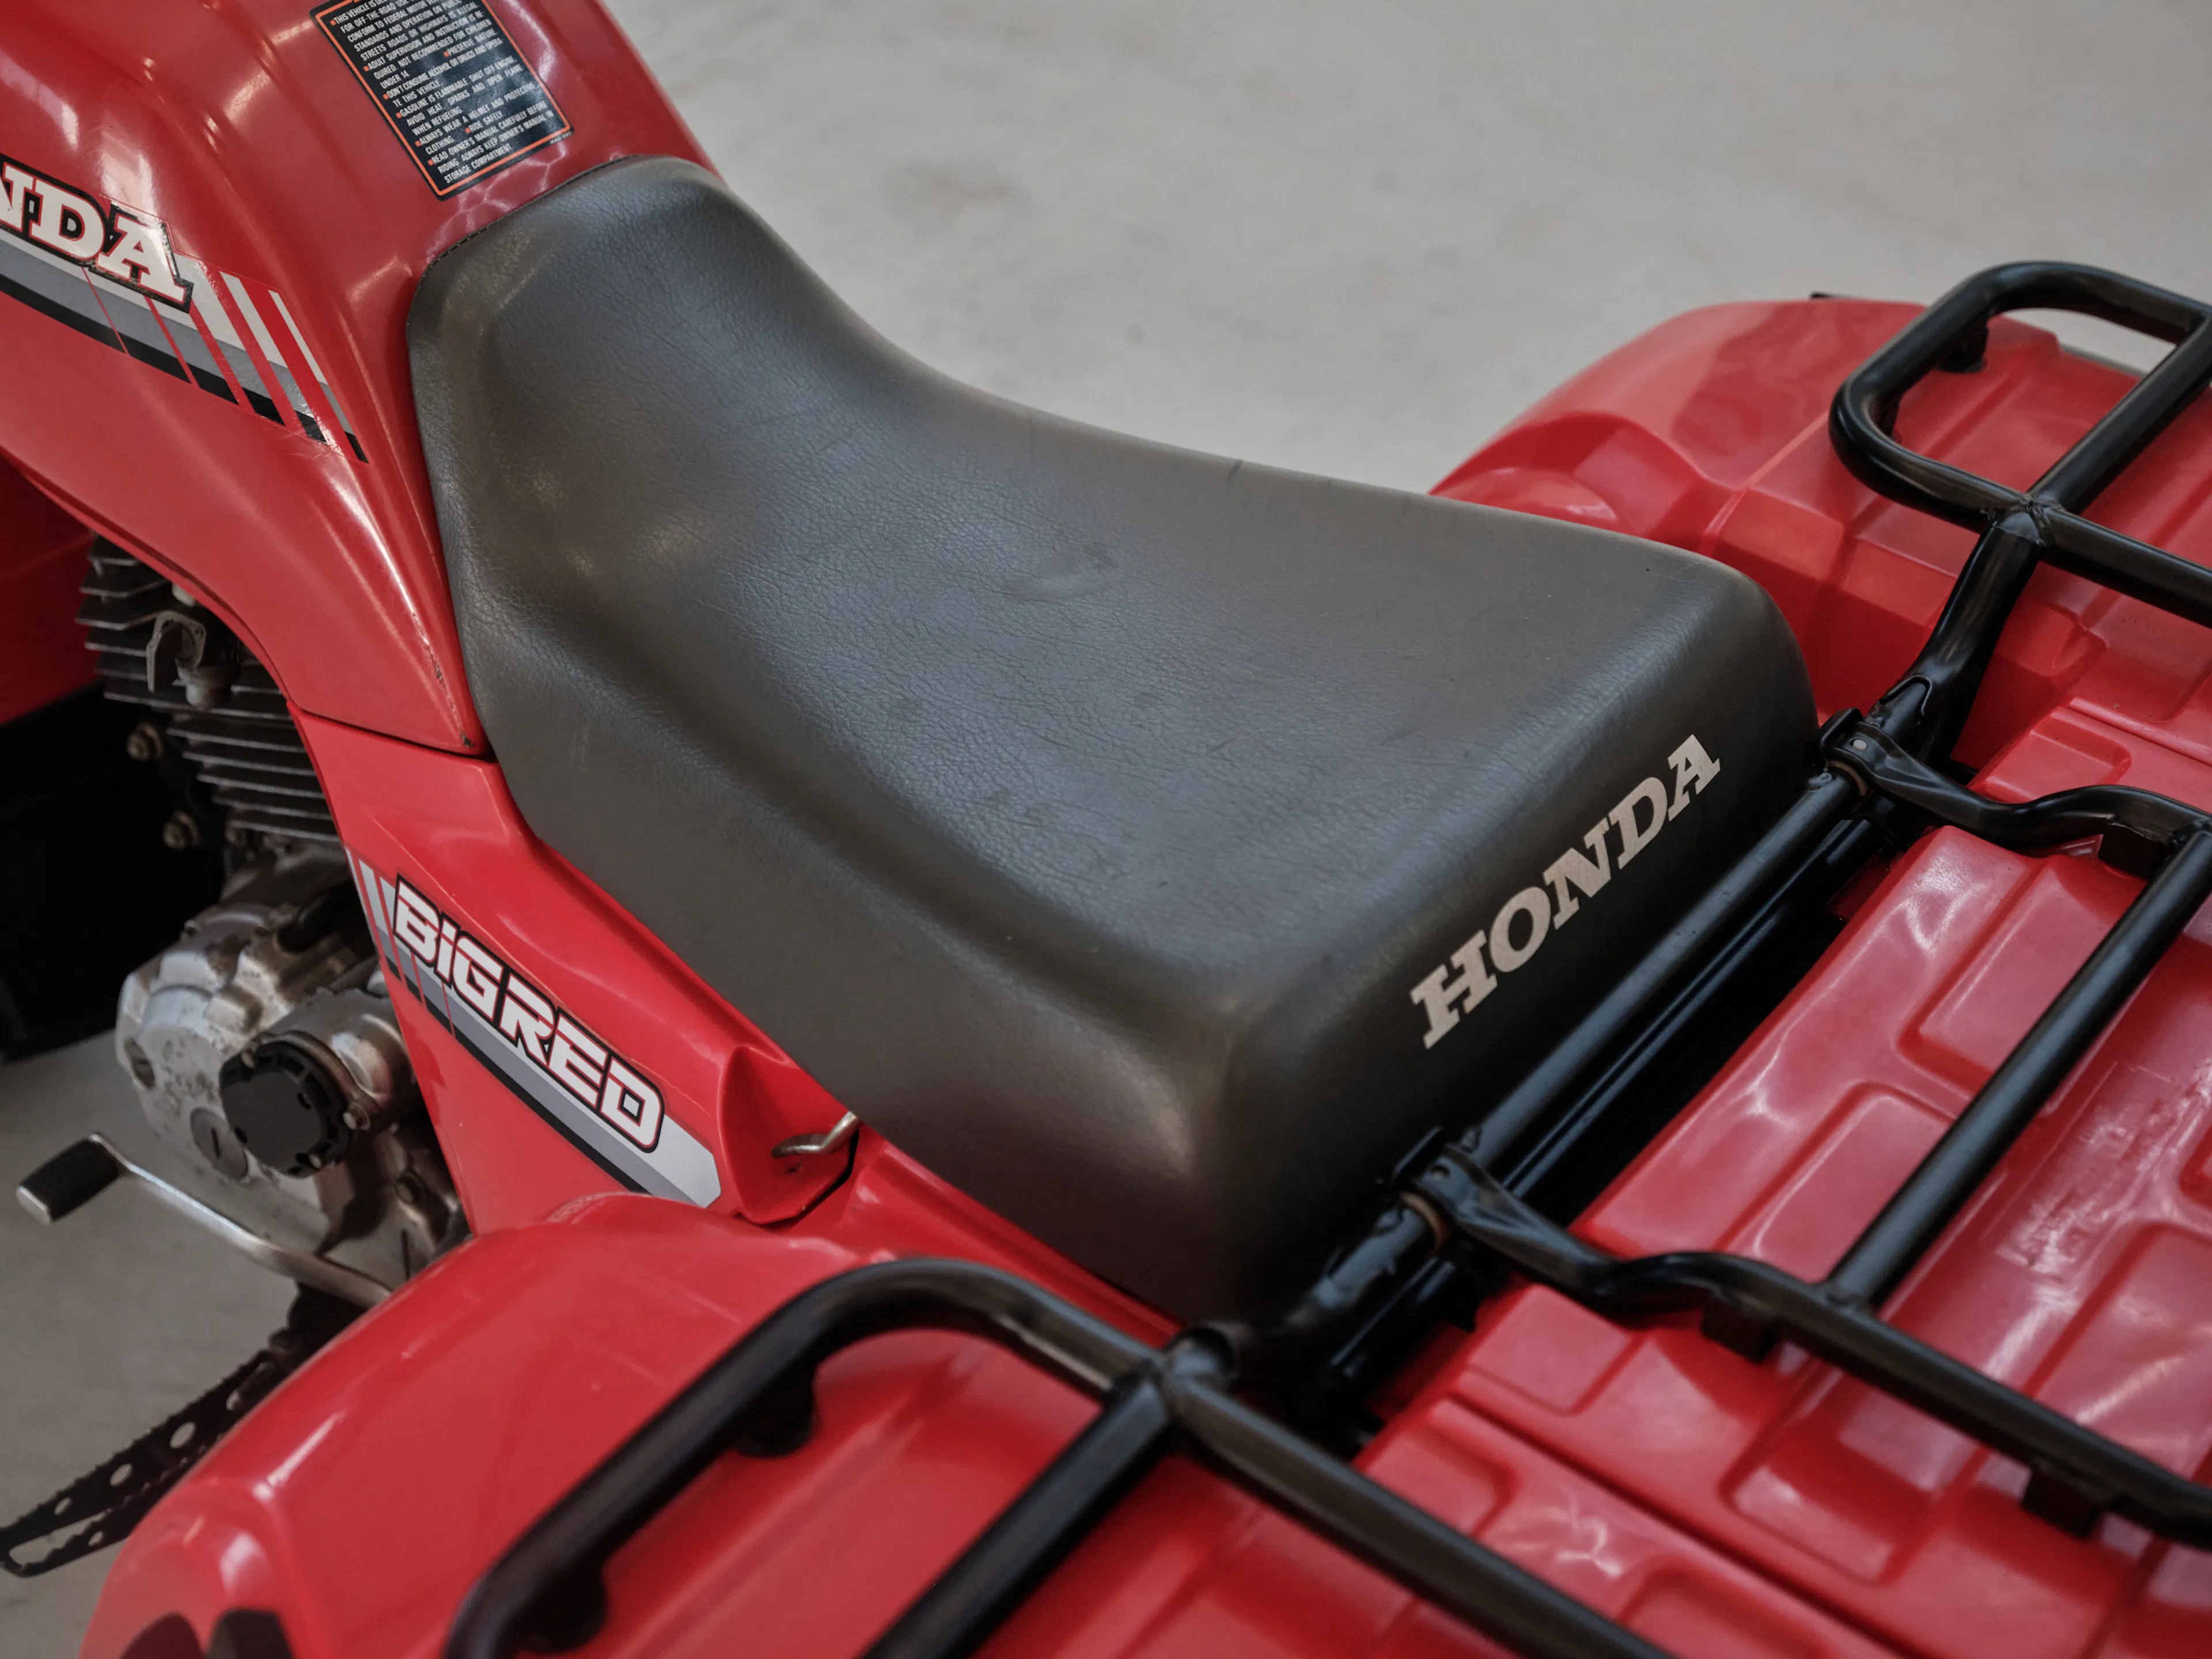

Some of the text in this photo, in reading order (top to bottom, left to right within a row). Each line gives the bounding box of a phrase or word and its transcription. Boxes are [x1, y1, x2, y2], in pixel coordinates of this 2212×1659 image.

[334, 13, 349, 24] THIS
[347, 3, 370, 17] VEHICLE
[340, 23, 354, 33] FOR
[347, 25, 376, 42] CONFORM
[374, 20, 384, 29] TO
[384, 10, 408, 25] FEDERAL
[407, 1, 427, 14] MOTOR
[354, 31, 389, 51] STANDARDS
[389, 24, 402, 35] AND
[402, 10, 433, 28] OPERATION
[433, 6, 443, 14] ON
[361, 44, 387, 60] STREETS
[387, 33, 408, 48] ROADS
[408, 29, 418, 37] OR
[418, 15, 448, 33] HIGHWAYS
[368, 56, 385, 70] ADULT
[386, 40, 422, 60] SUPERVISION
[422, 33, 435, 44] AND
[468, 14, 476, 22] IS
[398, 56, 411, 67] NOT
[411, 36, 453, 60] RECOMMENDED
[453, 31, 466, 40] FOR
[447, 39, 475, 56] PRESERVE
[380, 74, 402, 89] UNDER
[403, 73, 429, 90] CONSUME
[428, 63, 451, 77] ALCOHOL
[450, 58, 459, 67] OR
[457, 50, 476, 63] DRUGS
[475, 45, 487, 55] AND
[393, 99, 402, 107] TE
[402, 92, 417, 103] THIS
[400, 98, 429, 116] GASOLINE
[427, 94, 435, 103] IS
[469, 70, 484, 82] SHUT
[484, 65, 495, 75] OFF
[407, 112, 425, 126] AVOID
[448, 90, 470, 105] SPARKS
[472, 82, 486, 93] AND
[412, 122, 431, 135] WHEN
[420, 129, 443, 145] ALWAYS
[443, 119, 461, 132] WEAR
[468, 104, 490, 119] HELMET
[491, 98, 504, 109] AND
[431, 151, 448, 164] READ
[475, 126, 499, 141] MANUAL
[498, 111, 527, 130] CAREFULLY
[461, 146, 484, 161] ALWAYS
[484, 137, 499, 149] KEEP
[523, 113, 547, 128] MANUAL
[469, 120, 483, 132] RIDE
[445, 165, 471, 183] STORAGE
[1410, 733, 1721, 1050] HONDA
